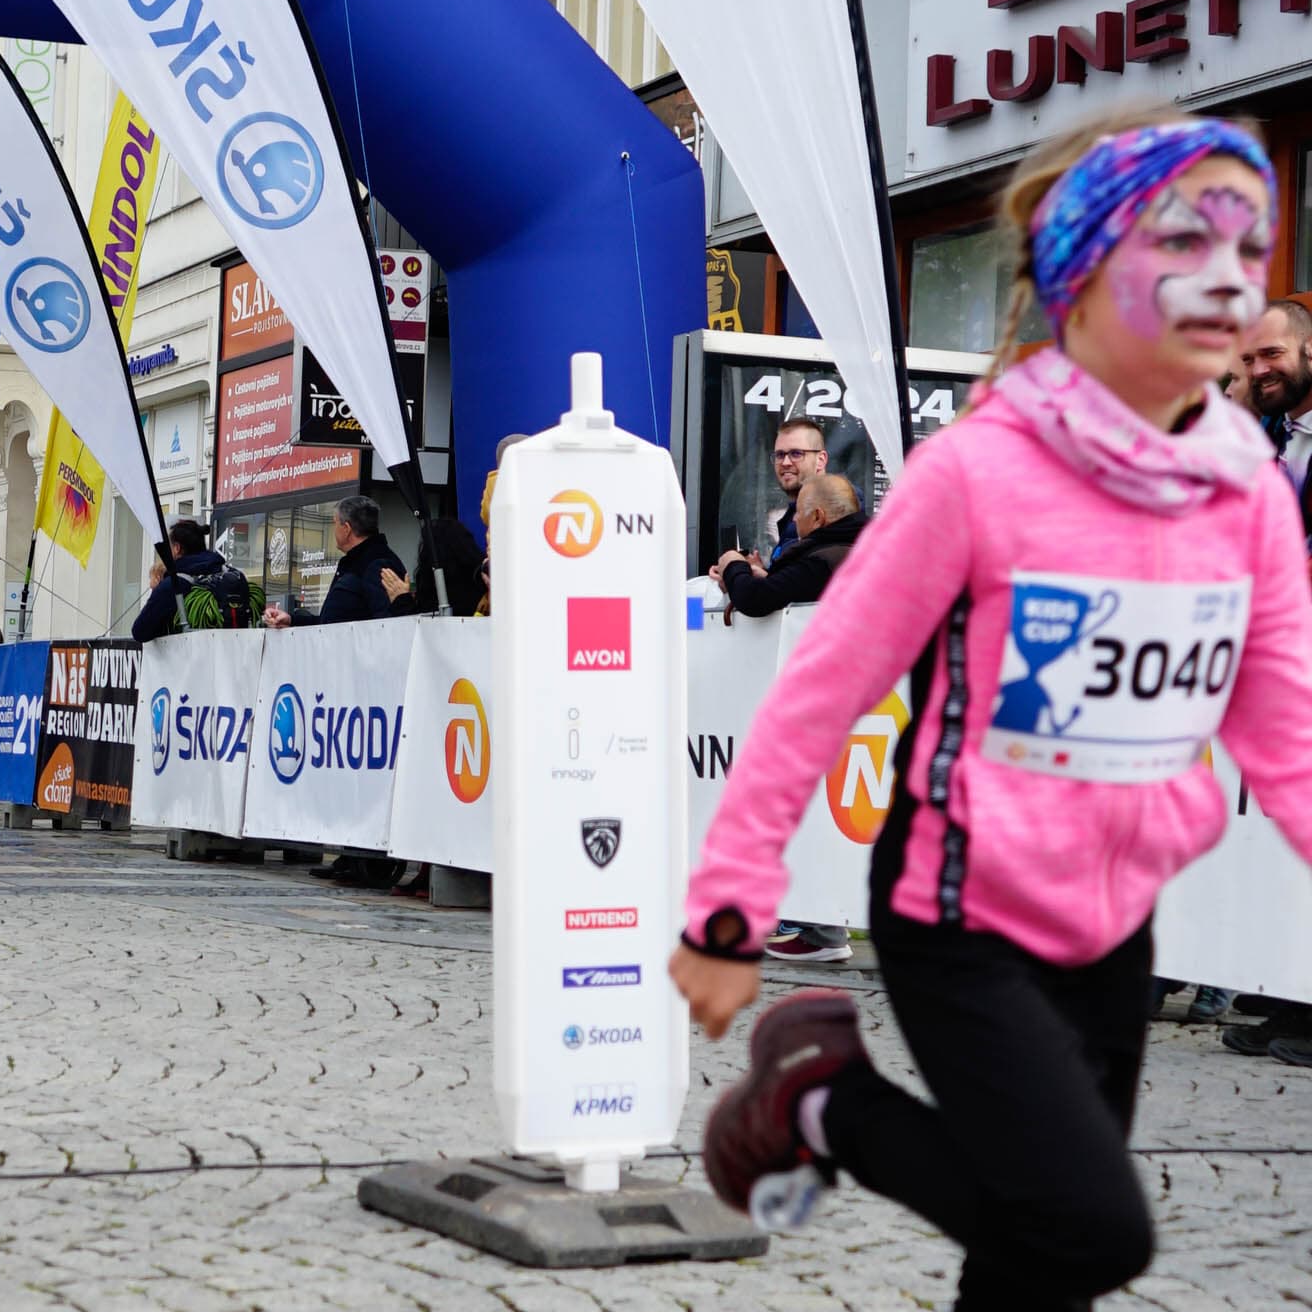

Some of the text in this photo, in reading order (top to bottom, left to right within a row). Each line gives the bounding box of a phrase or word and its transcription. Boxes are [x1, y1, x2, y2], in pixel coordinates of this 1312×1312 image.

[231, 278, 280, 323] SLAV
[616, 513, 653, 534] NN
[573, 650, 625, 666] AVON
[1084, 639, 1234, 700] 3040
[47, 709, 85, 738] REGION
[87, 702, 135, 746] ZDARM
[688, 734, 734, 780] NN
[551, 768, 596, 782] innogy
[568, 911, 636, 926] NUTREND
[589, 1027, 642, 1045] ŠKODA
[573, 1096, 633, 1116] KPMG
